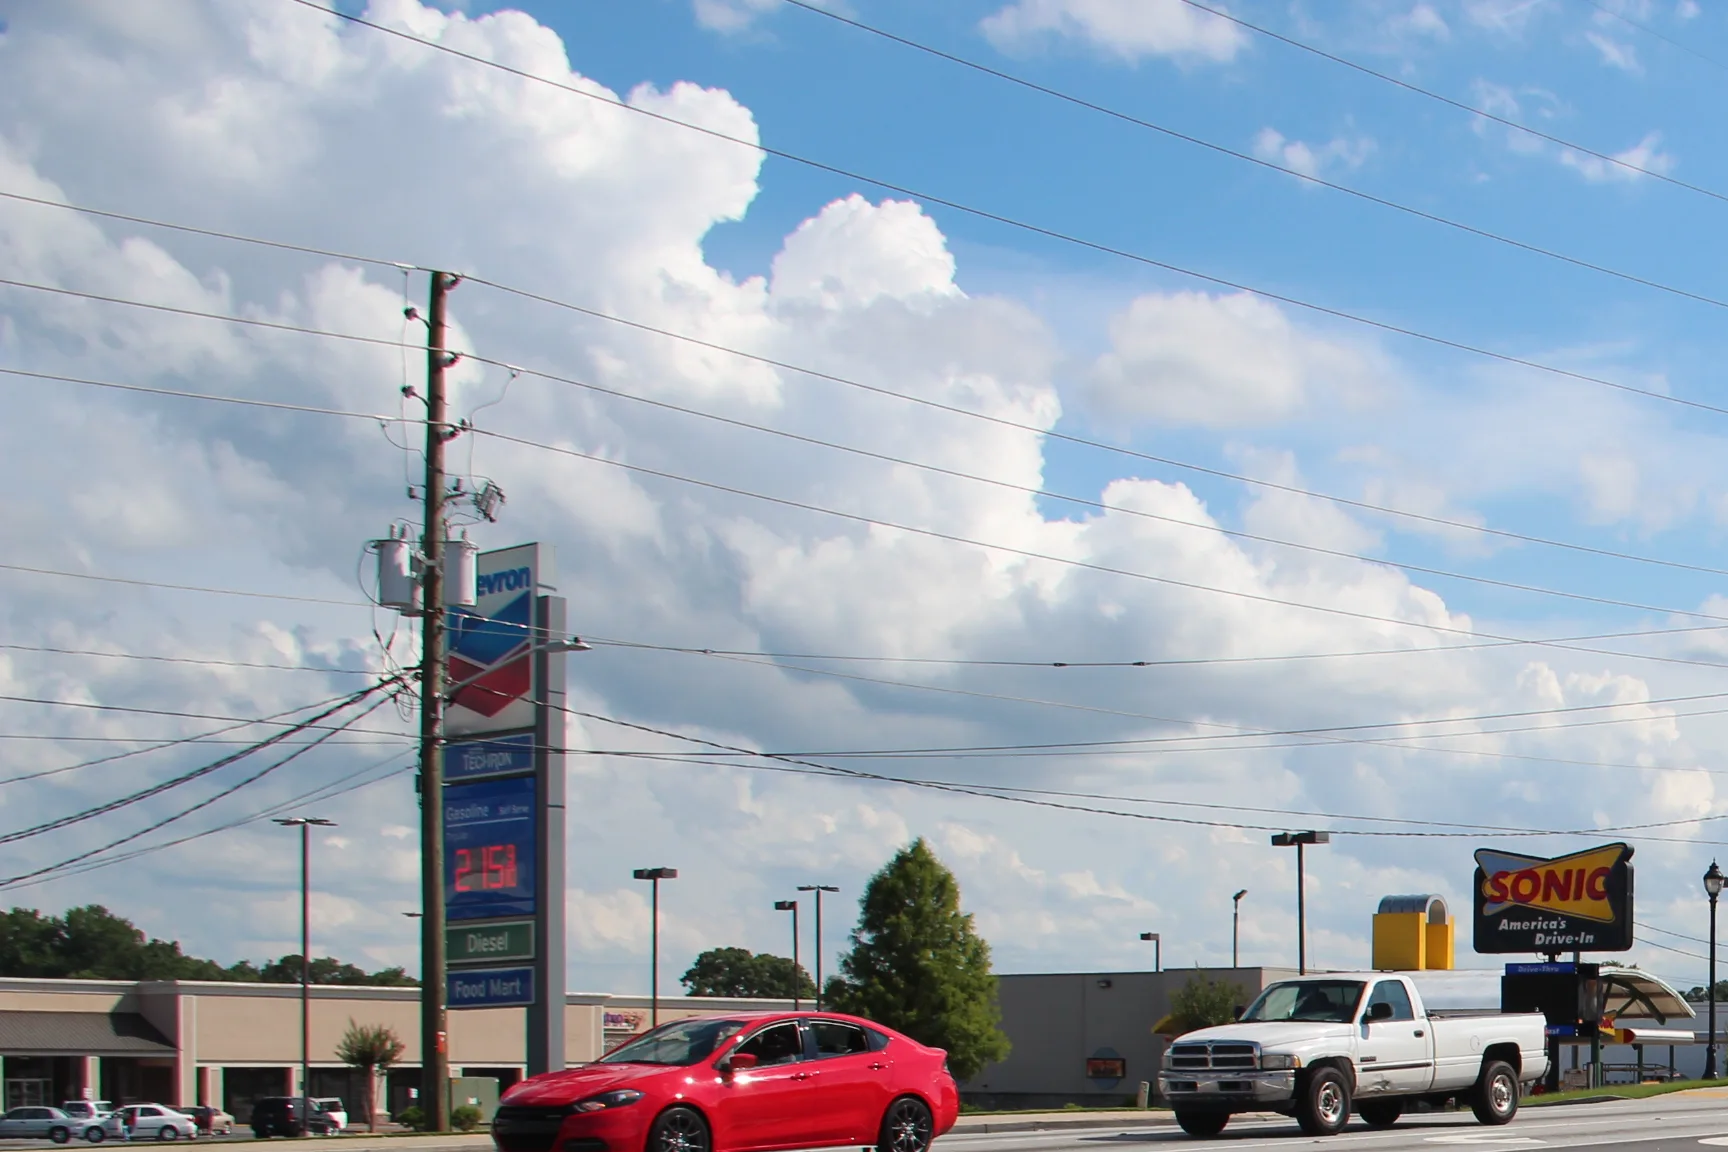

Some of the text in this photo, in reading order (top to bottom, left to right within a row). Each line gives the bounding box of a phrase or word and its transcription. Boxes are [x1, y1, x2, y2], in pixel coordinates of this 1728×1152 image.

[478, 566, 531, 597] evron
[462, 751, 513, 771] TECHRON
[446, 804, 489, 820] Gasoline
[1487, 866, 1612, 904] SONIC
[1498, 917, 1567, 930] America's
[467, 931, 508, 953] Diesel
[455, 977, 522, 998] Food Mart
